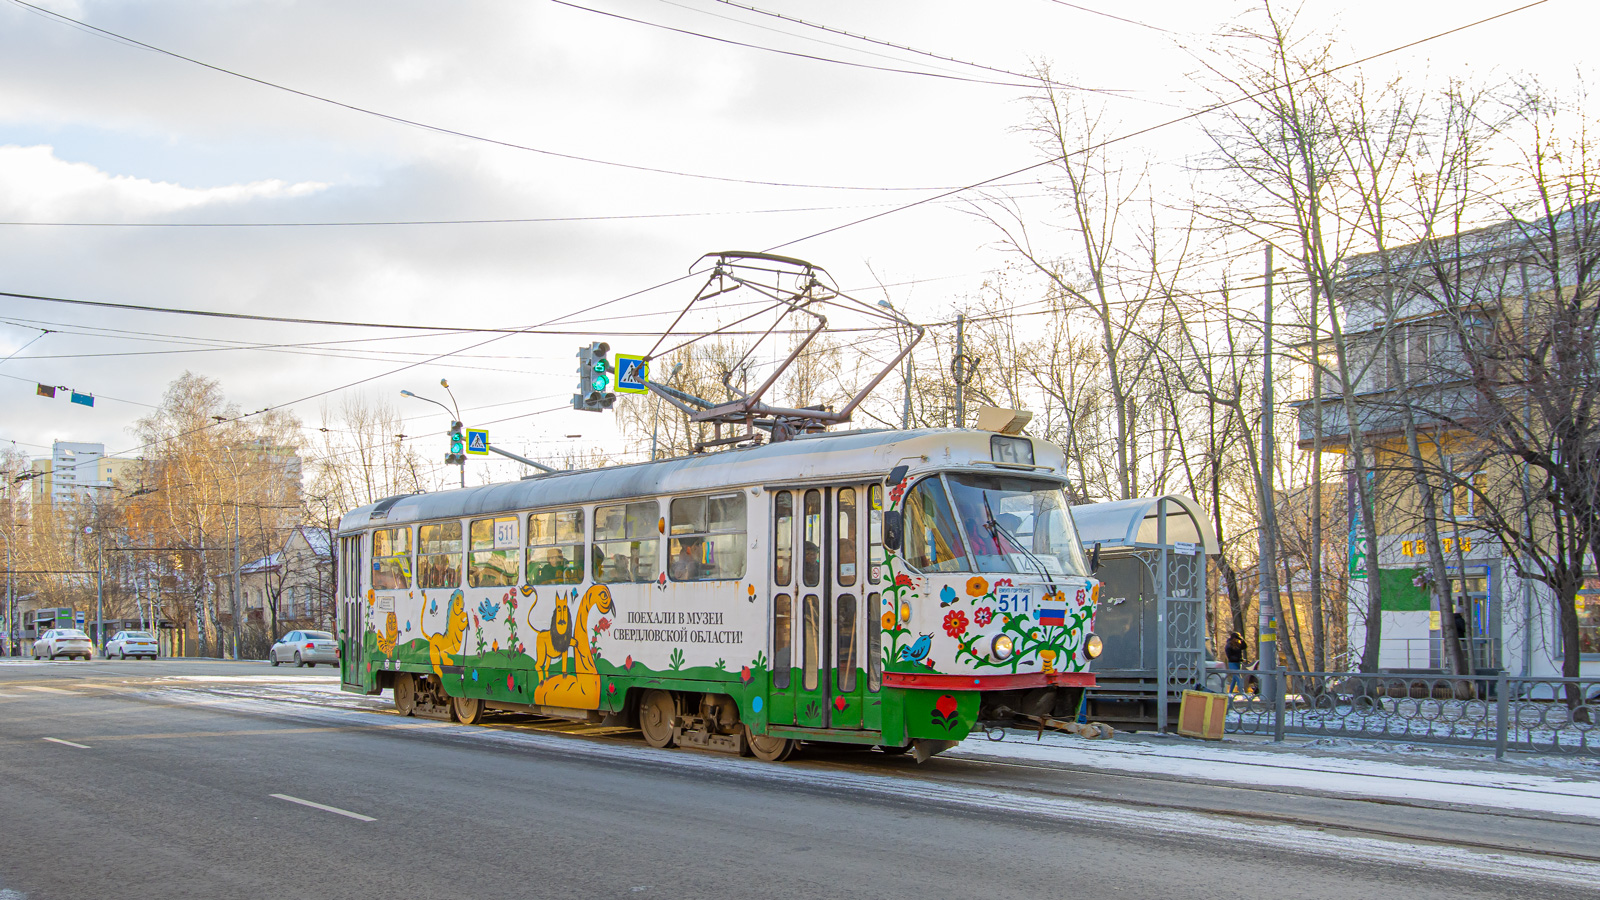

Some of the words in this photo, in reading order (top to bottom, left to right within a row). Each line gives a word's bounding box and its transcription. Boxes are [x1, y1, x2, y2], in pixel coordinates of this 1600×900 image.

[498, 524, 513, 541] 511
[1401, 537, 1471, 557] ЦВТЫ
[998, 594, 1028, 611] 511
[627, 611, 675, 624] ПОЕХАЛИ
[678, 612, 685, 624] В
[686, 612, 724, 625] МУЗЕИ
[613, 627, 688, 643] СВЕРДЛОВСКОЙ
[690, 630, 743, 644] ОБЛАСТИ!
